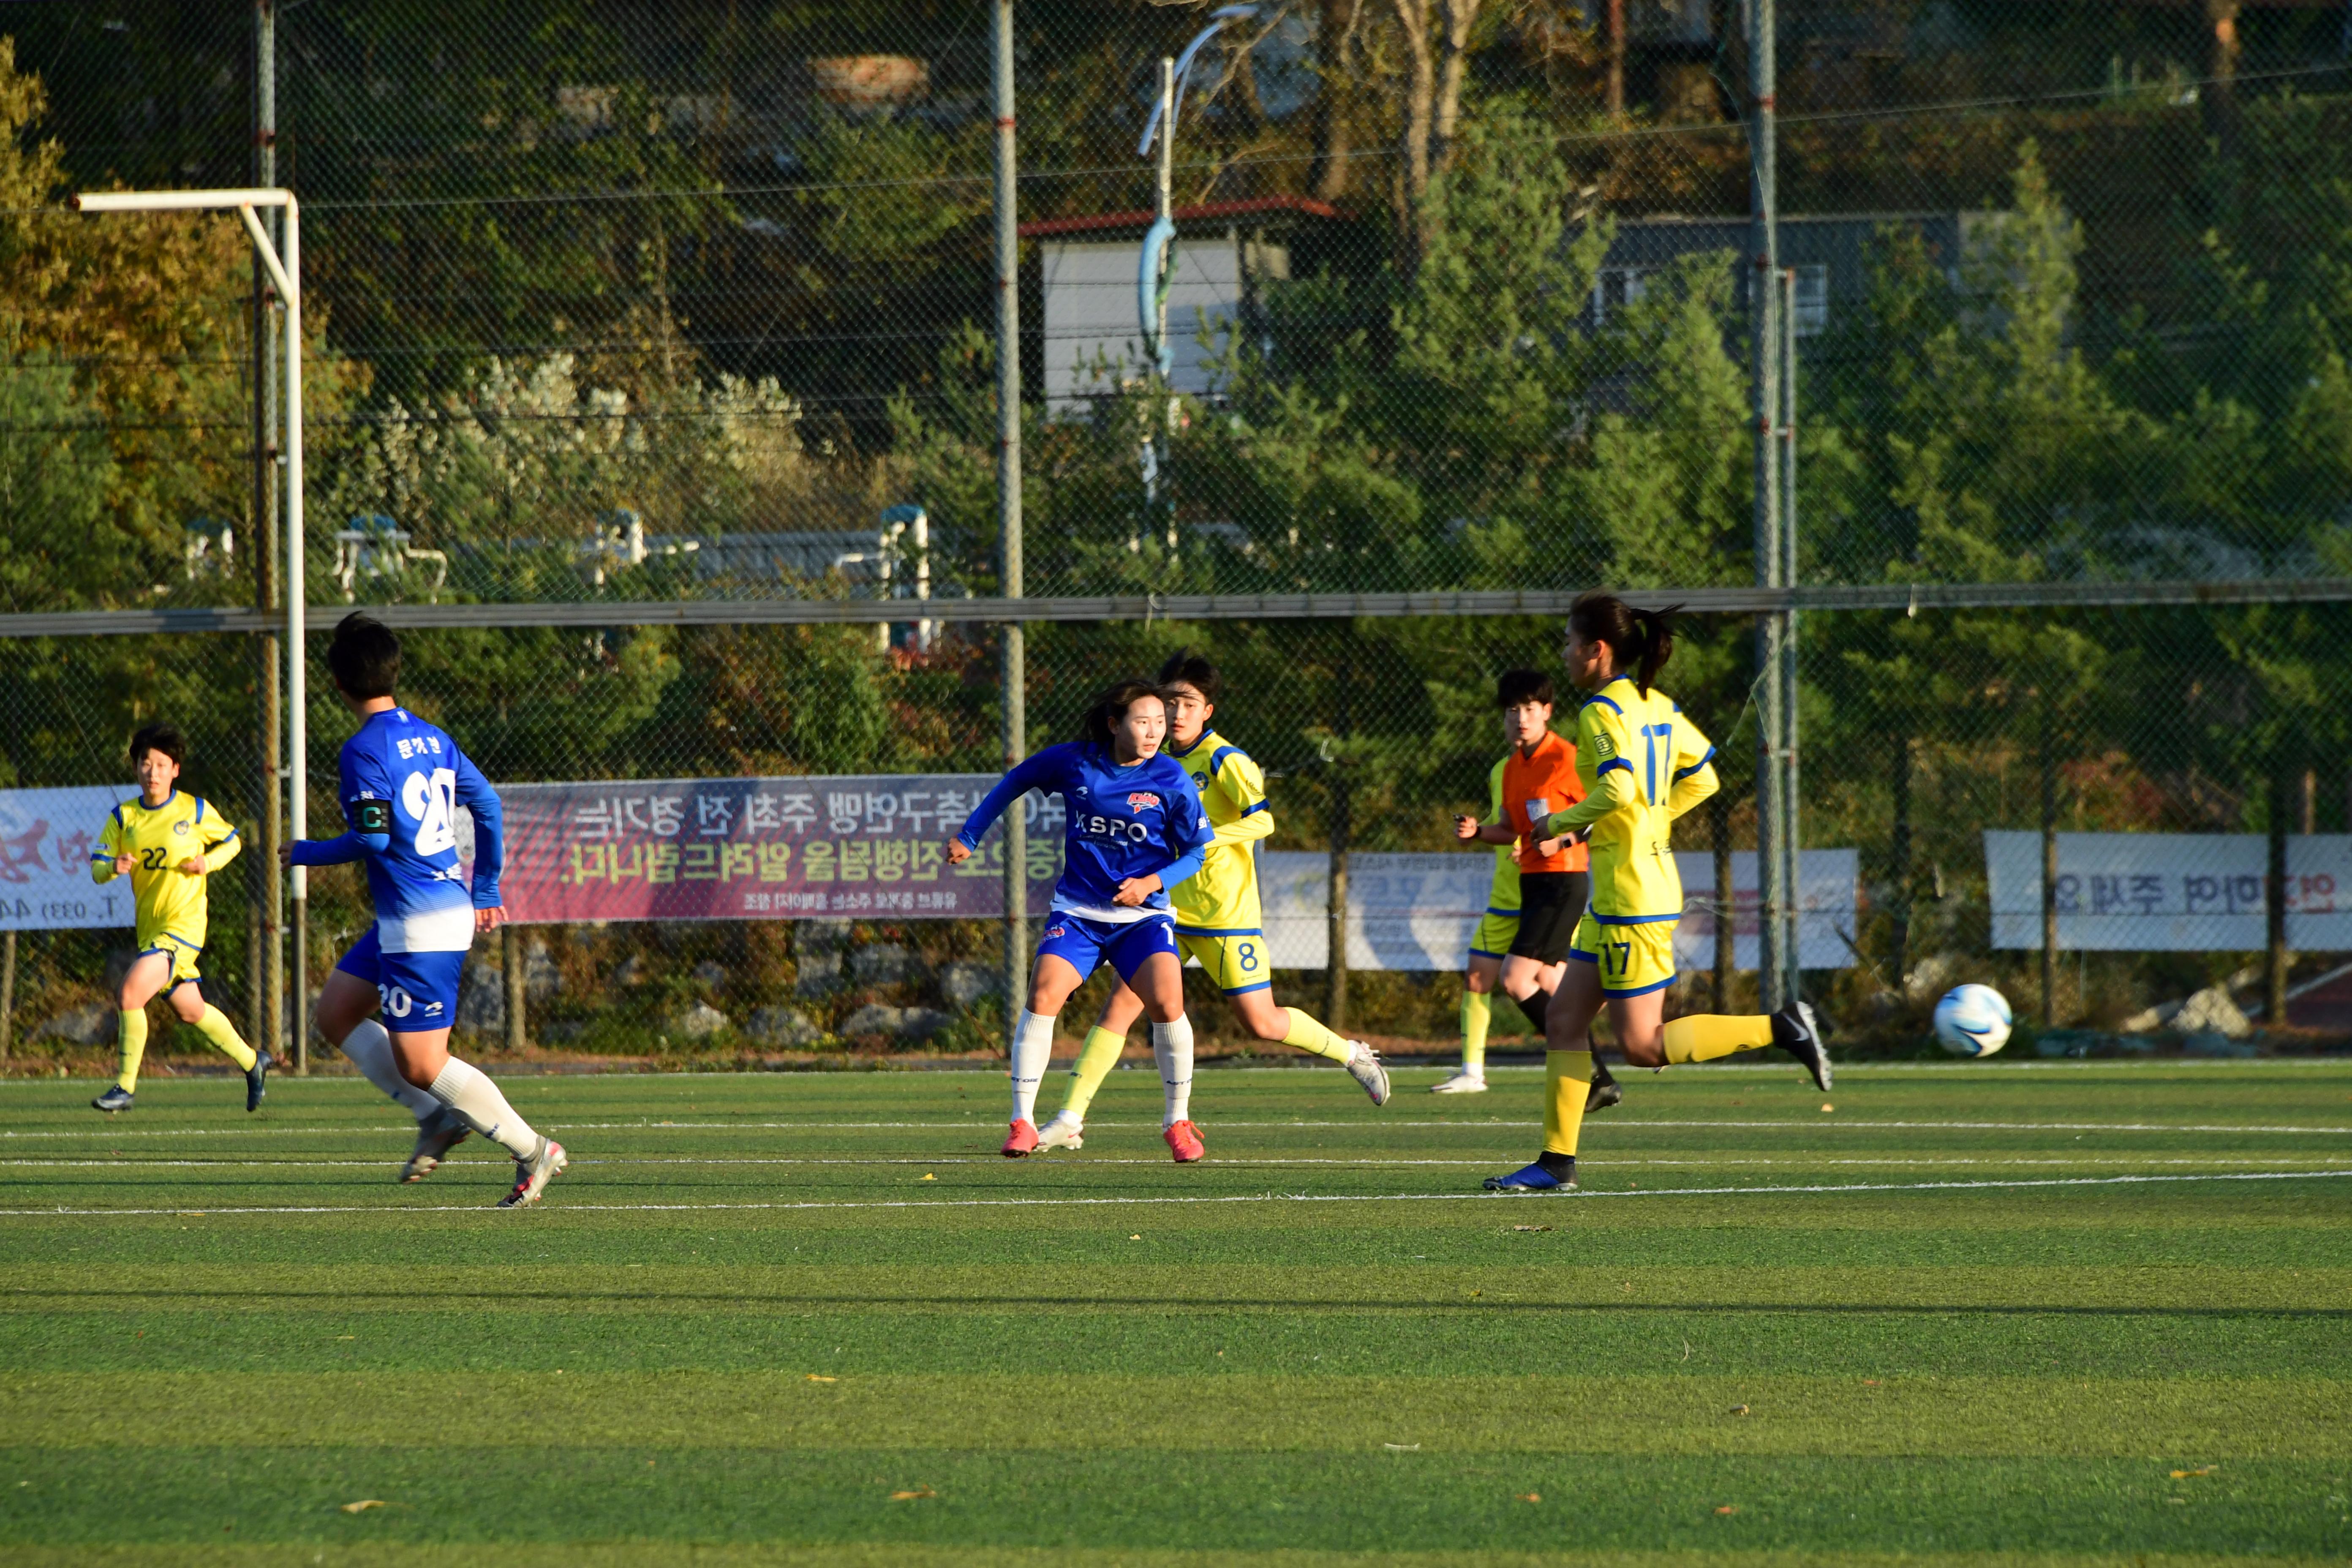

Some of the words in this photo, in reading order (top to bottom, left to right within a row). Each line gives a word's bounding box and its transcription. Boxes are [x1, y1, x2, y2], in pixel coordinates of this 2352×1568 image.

[1641, 723, 1672, 807] 17
[363, 807, 381, 828] C
[1075, 810, 1147, 842] KSPO
[141, 847, 167, 870] 22
[1238, 942, 1258, 972] 8
[1603, 942, 1630, 976] 17
